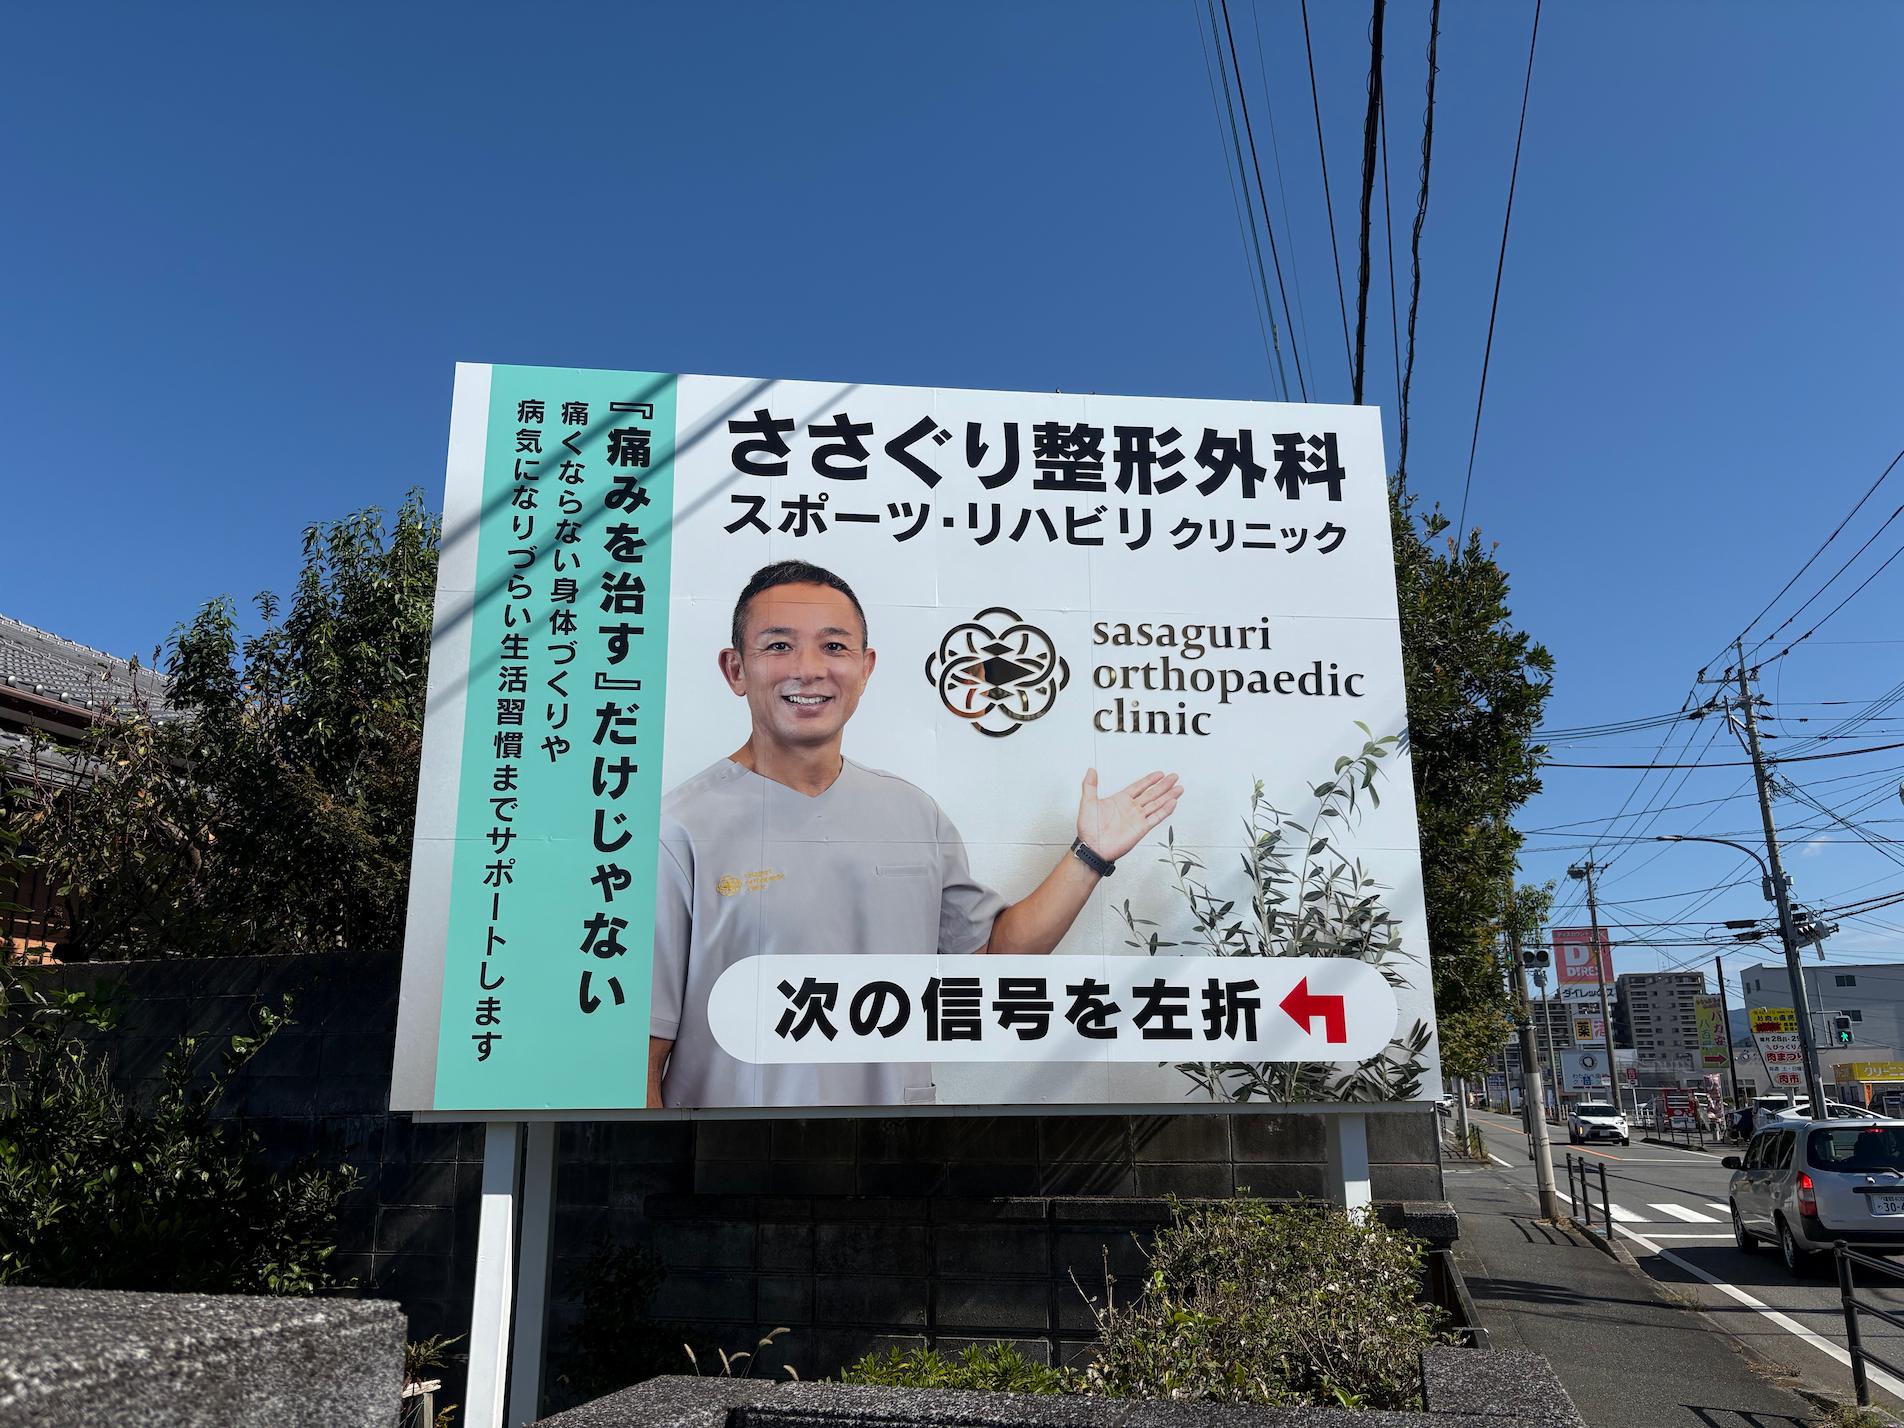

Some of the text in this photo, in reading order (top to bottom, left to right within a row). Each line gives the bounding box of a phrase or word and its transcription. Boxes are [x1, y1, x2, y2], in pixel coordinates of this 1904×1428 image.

[728, 408, 1346, 502] ささぐり整形外科
[1170, 517, 1347, 555] クリニック
[541, 401, 589, 763] 痛くならない身体づくりや
[1093, 616, 1272, 659] sasaguri
[580, 401, 654, 1014] 『痛みを治す』だけじゃない
[1093, 656, 1365, 704] orthopaedic
[472, 399, 546, 1062] 病気になりづらい生活習慣までサポートします
[1094, 698, 1212, 736] clinic
[774, 976, 1261, 1043] 次の信号を左折
